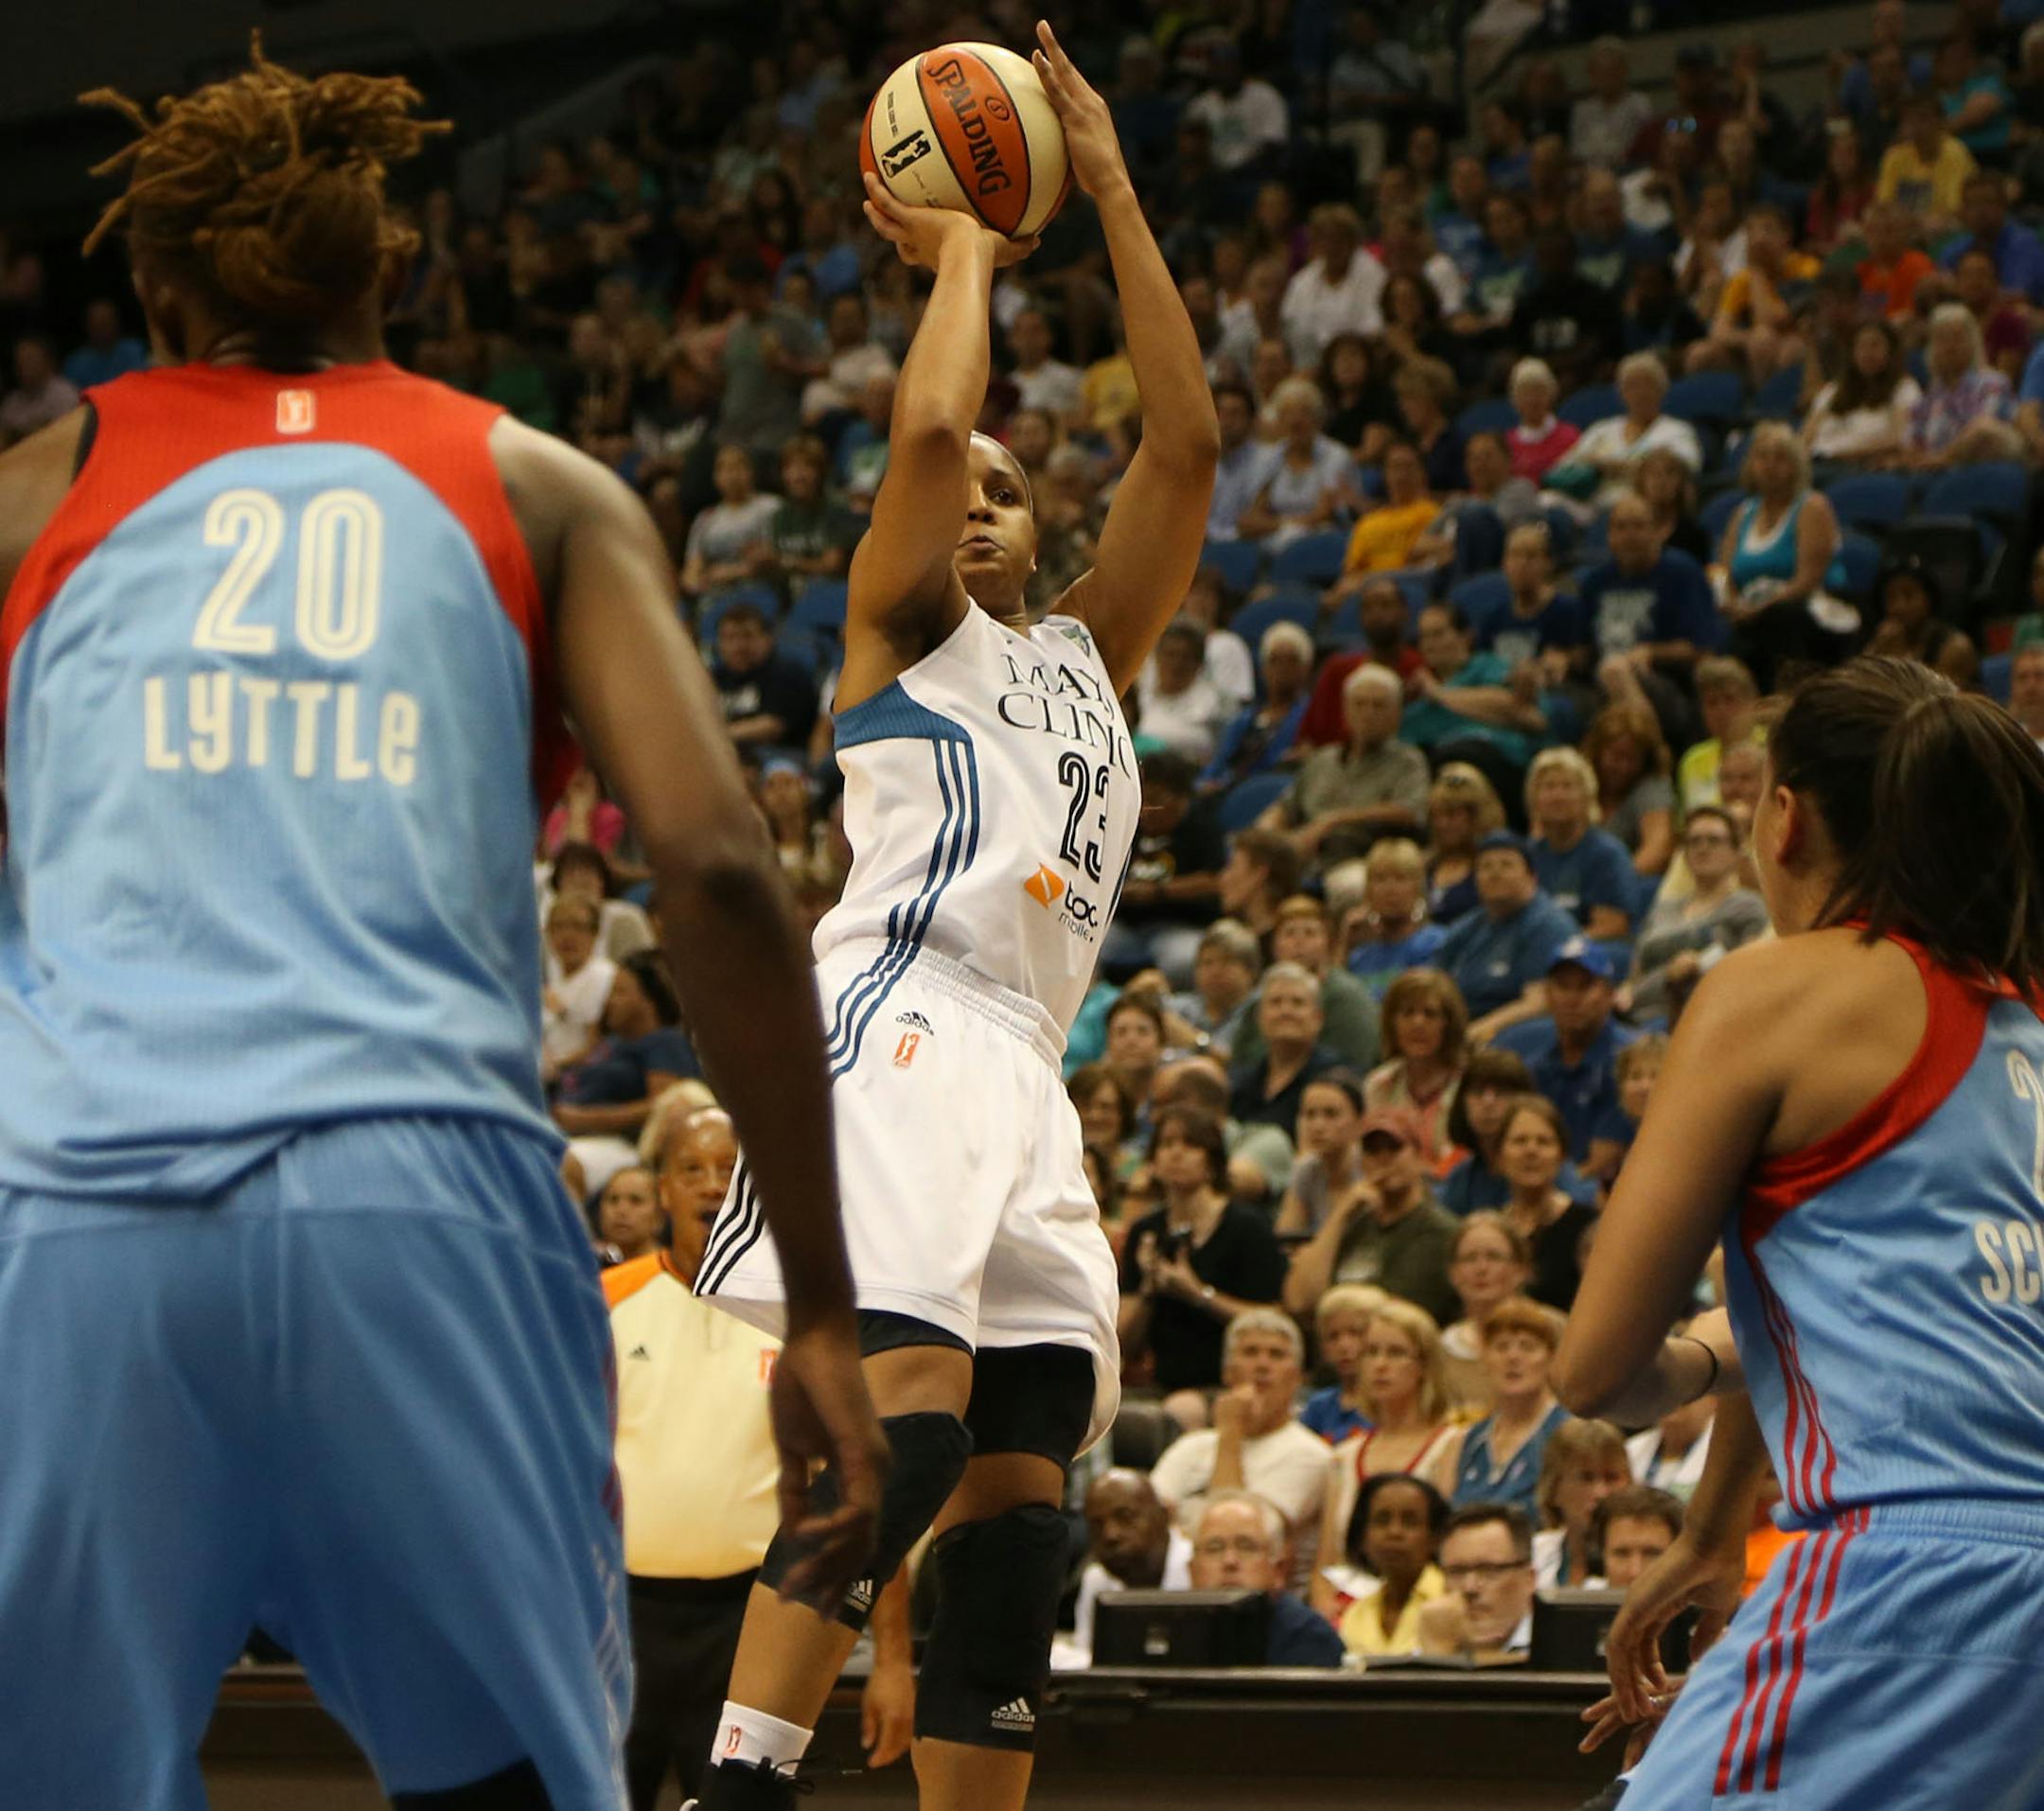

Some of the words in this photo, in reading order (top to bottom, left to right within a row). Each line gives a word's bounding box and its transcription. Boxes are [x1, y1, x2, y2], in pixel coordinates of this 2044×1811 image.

[925, 59, 1013, 197] SPALDING
[192, 487, 385, 661] 20
[895, 1015, 935, 1036] adidas
[2006, 1048, 2044, 1207] 2
[991, 1711, 1035, 1723] adidas
